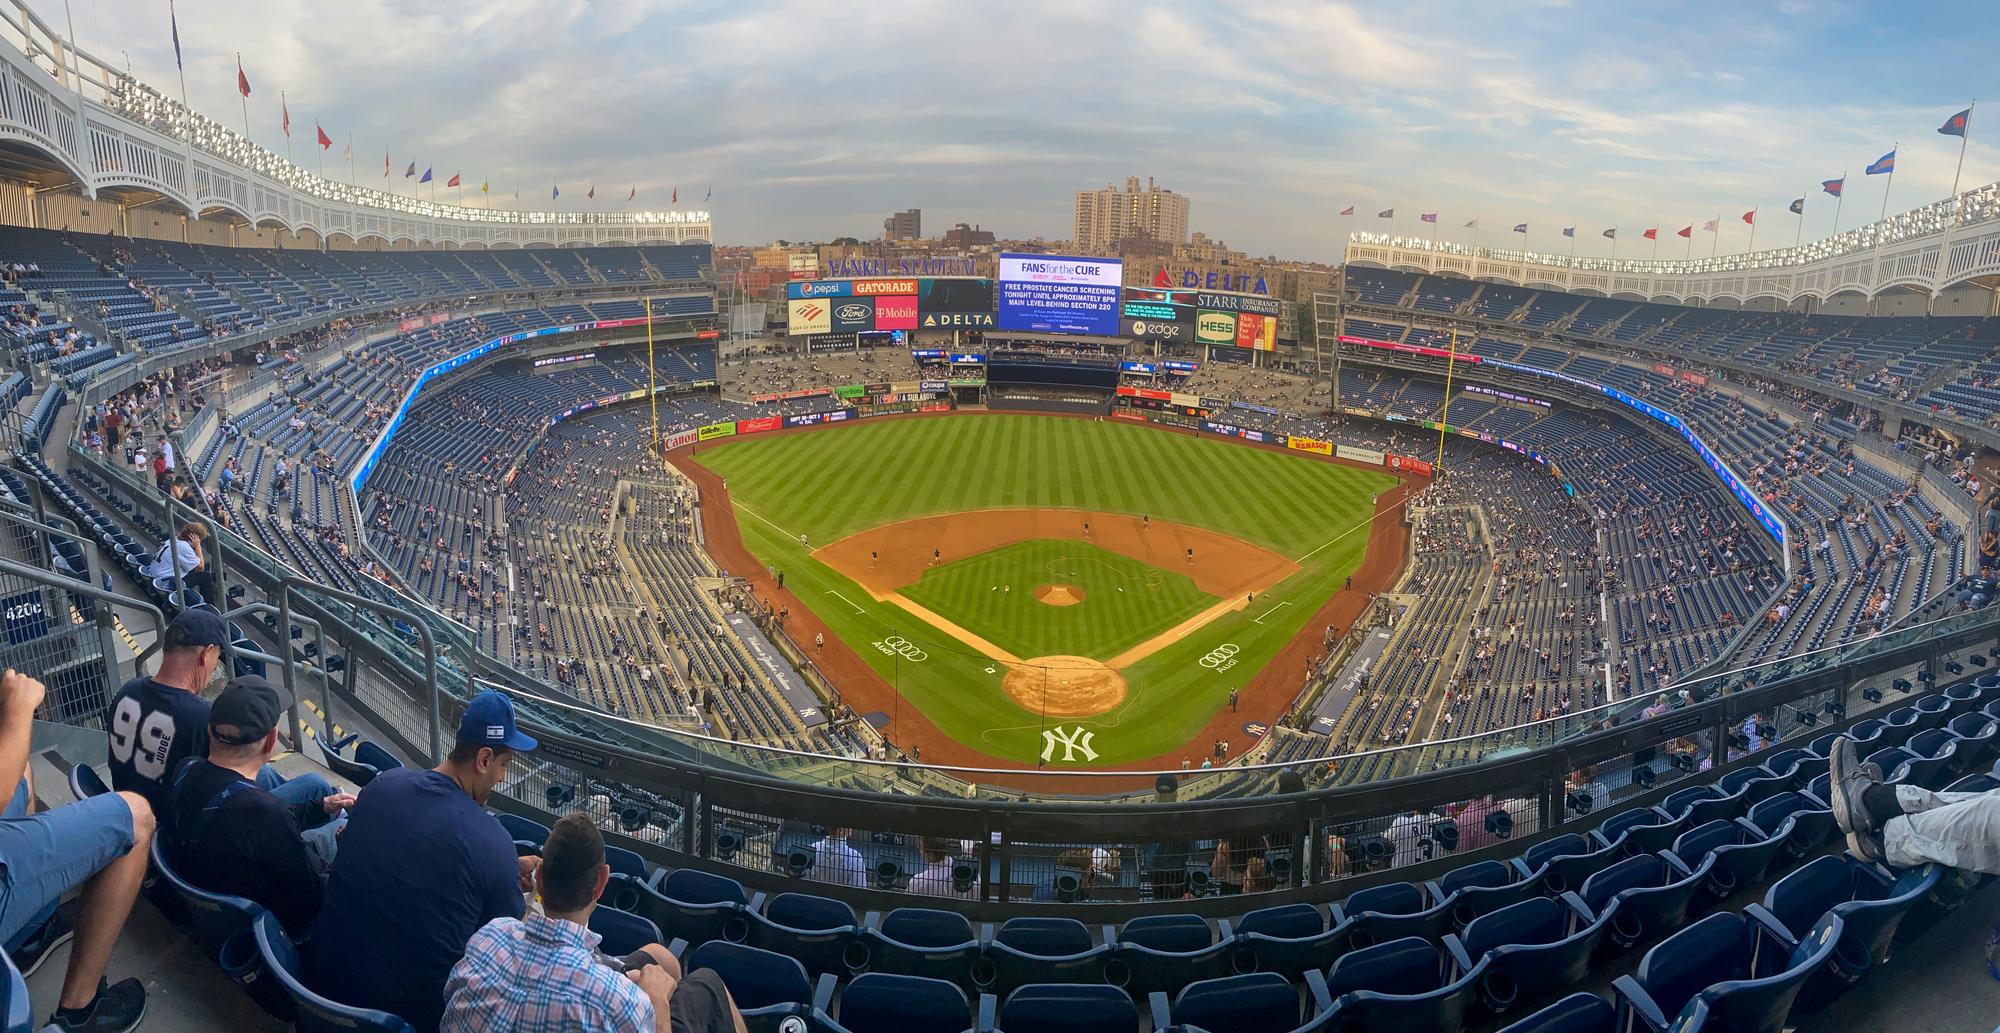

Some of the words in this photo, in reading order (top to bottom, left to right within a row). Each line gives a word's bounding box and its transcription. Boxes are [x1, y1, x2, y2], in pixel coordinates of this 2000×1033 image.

[1022, 263, 1046, 272] FANS
[1046, 264, 1057, 273] for
[1060, 264, 1074, 274] the
[1075, 266, 1100, 276] CURE
[814, 284, 840, 295] pepsi
[856, 282, 914, 294] GATORADE
[1183, 271, 1268, 295] DELTA
[1052, 294, 1100, 302] APPROXIMATELY
[1198, 294, 1238, 309] STARR
[1242, 298, 1279, 308] INSURANCE
[842, 306, 865, 318] Ford
[1242, 304, 1278, 313] COMPANIES
[941, 314, 992, 325] DELTA
[1148, 322, 1179, 338] edge
[1200, 321, 1232, 333] HESS
[701, 427, 720, 435] Gillette
[665, 433, 696, 449] Canon
[872, 641, 896, 657] Audi
[1216, 659, 1238, 673] Audi
[110, 696, 176, 780] 99
[1041, 726, 1099, 762] NY
[156, 734, 171, 765] JUDGE
